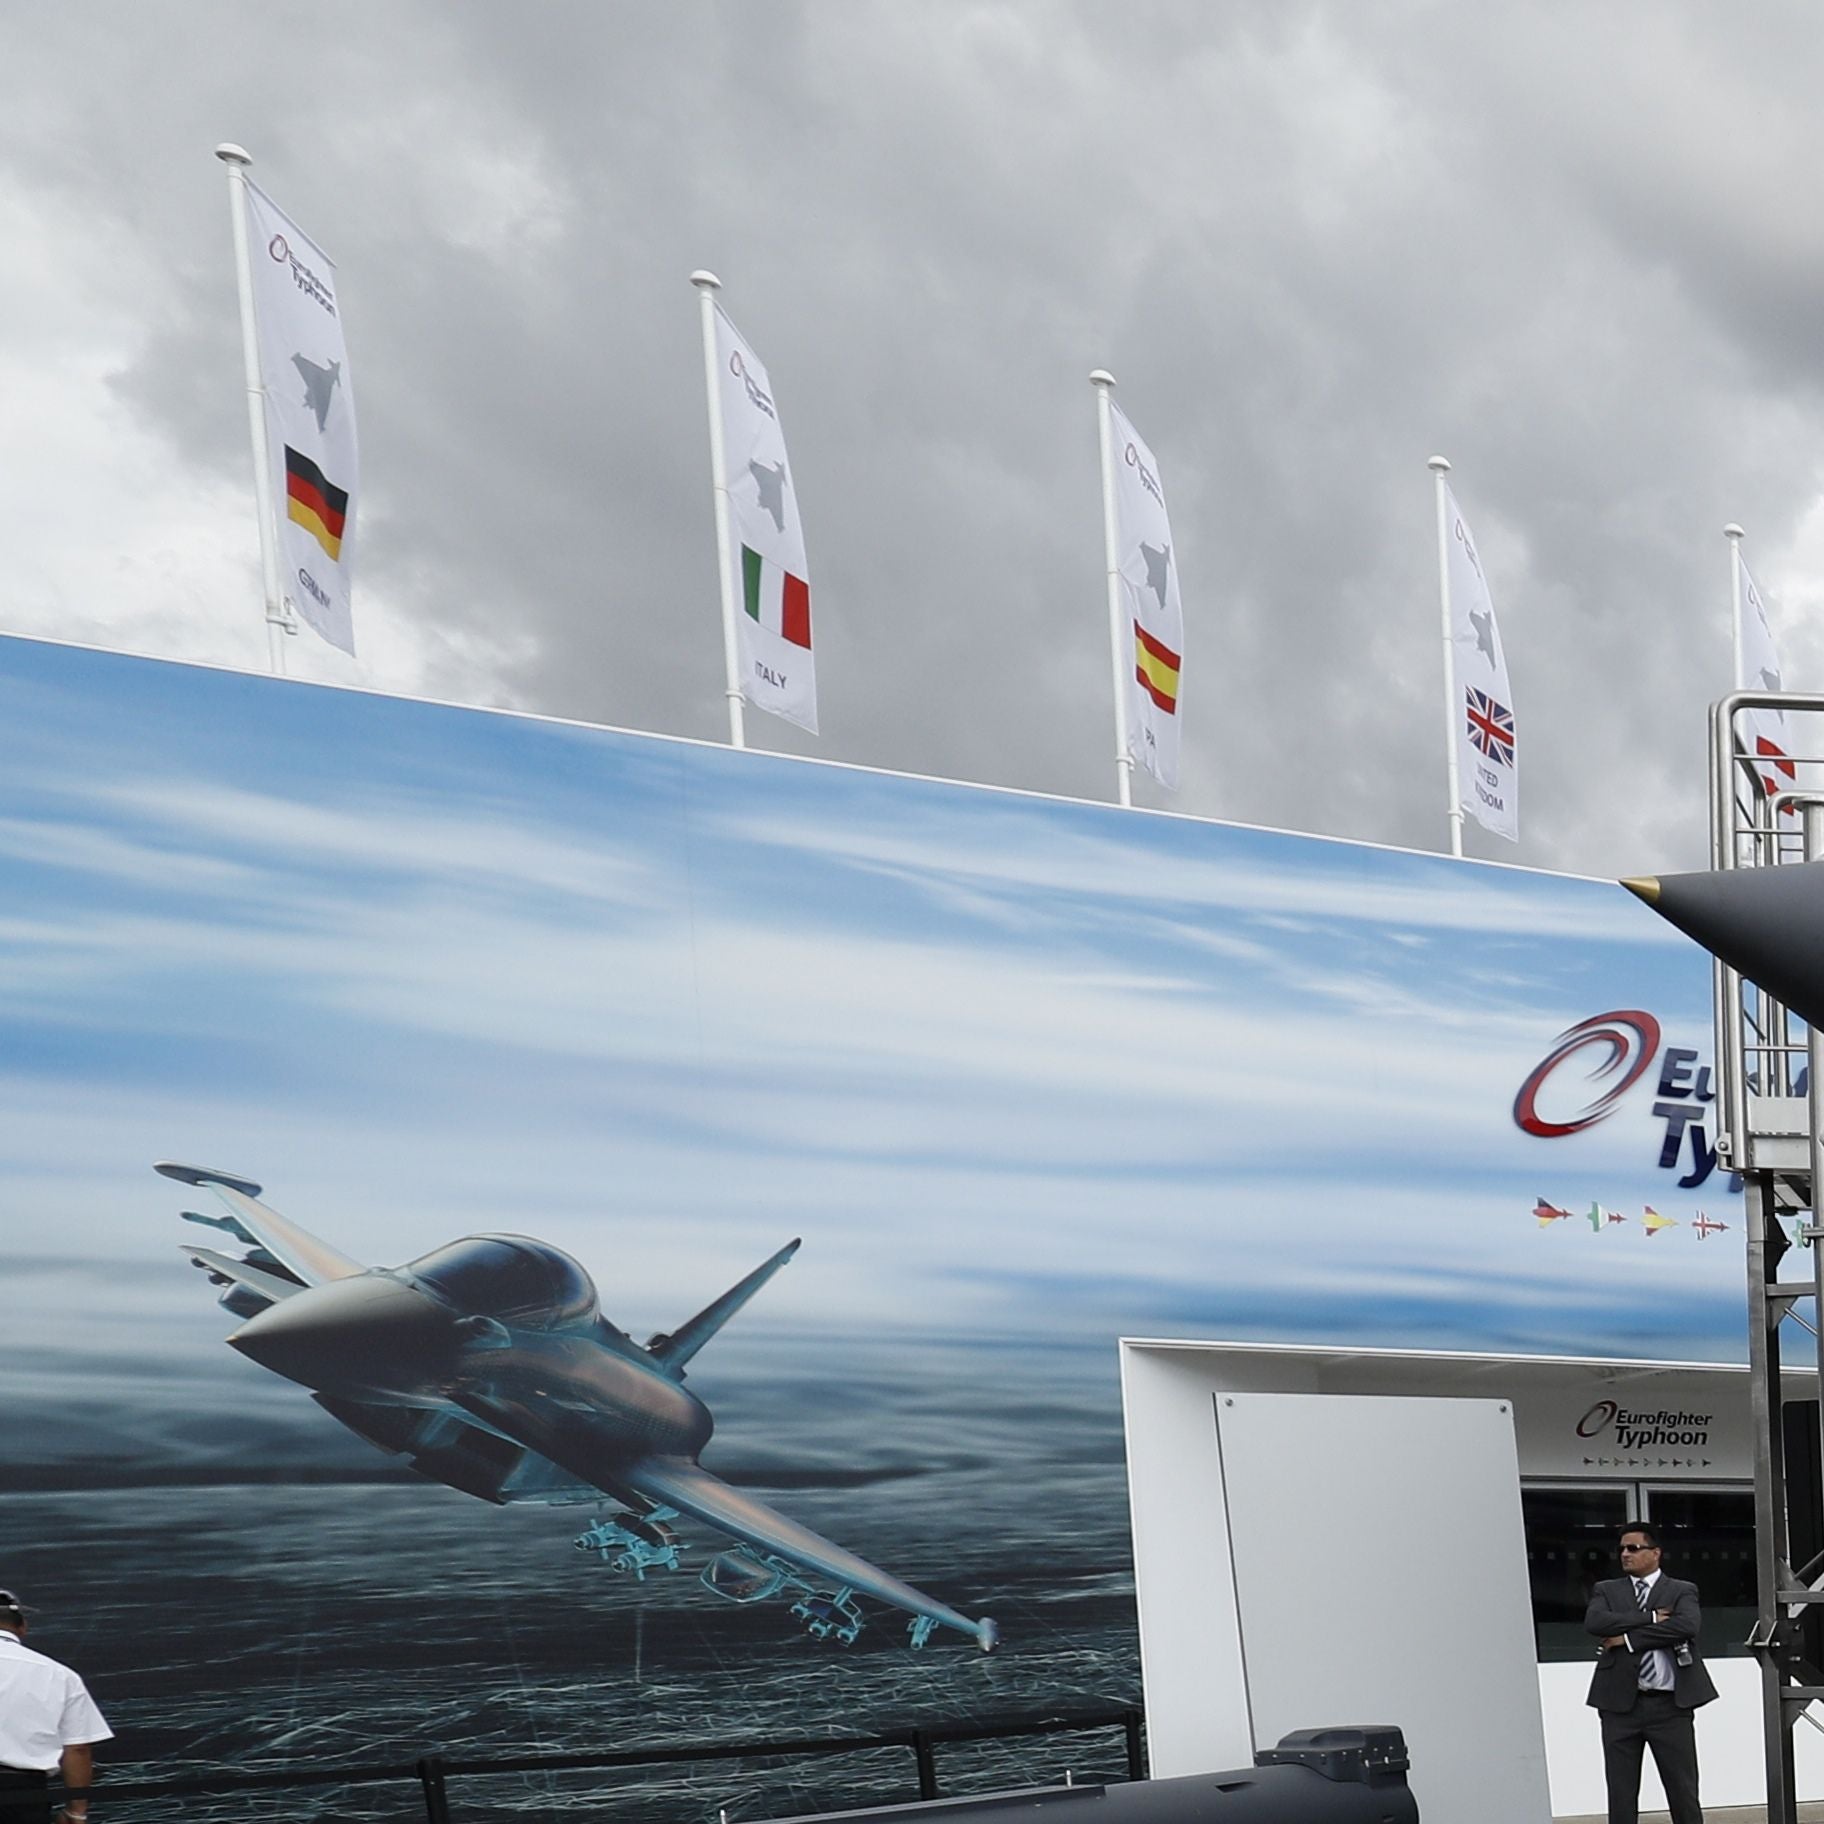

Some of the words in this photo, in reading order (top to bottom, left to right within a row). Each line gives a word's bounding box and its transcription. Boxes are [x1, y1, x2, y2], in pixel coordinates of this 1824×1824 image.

[755, 660, 787, 689] ITALY
[1616, 1409, 1713, 1428] Eurofighter
[1615, 1425, 1708, 1449] Typhoon
